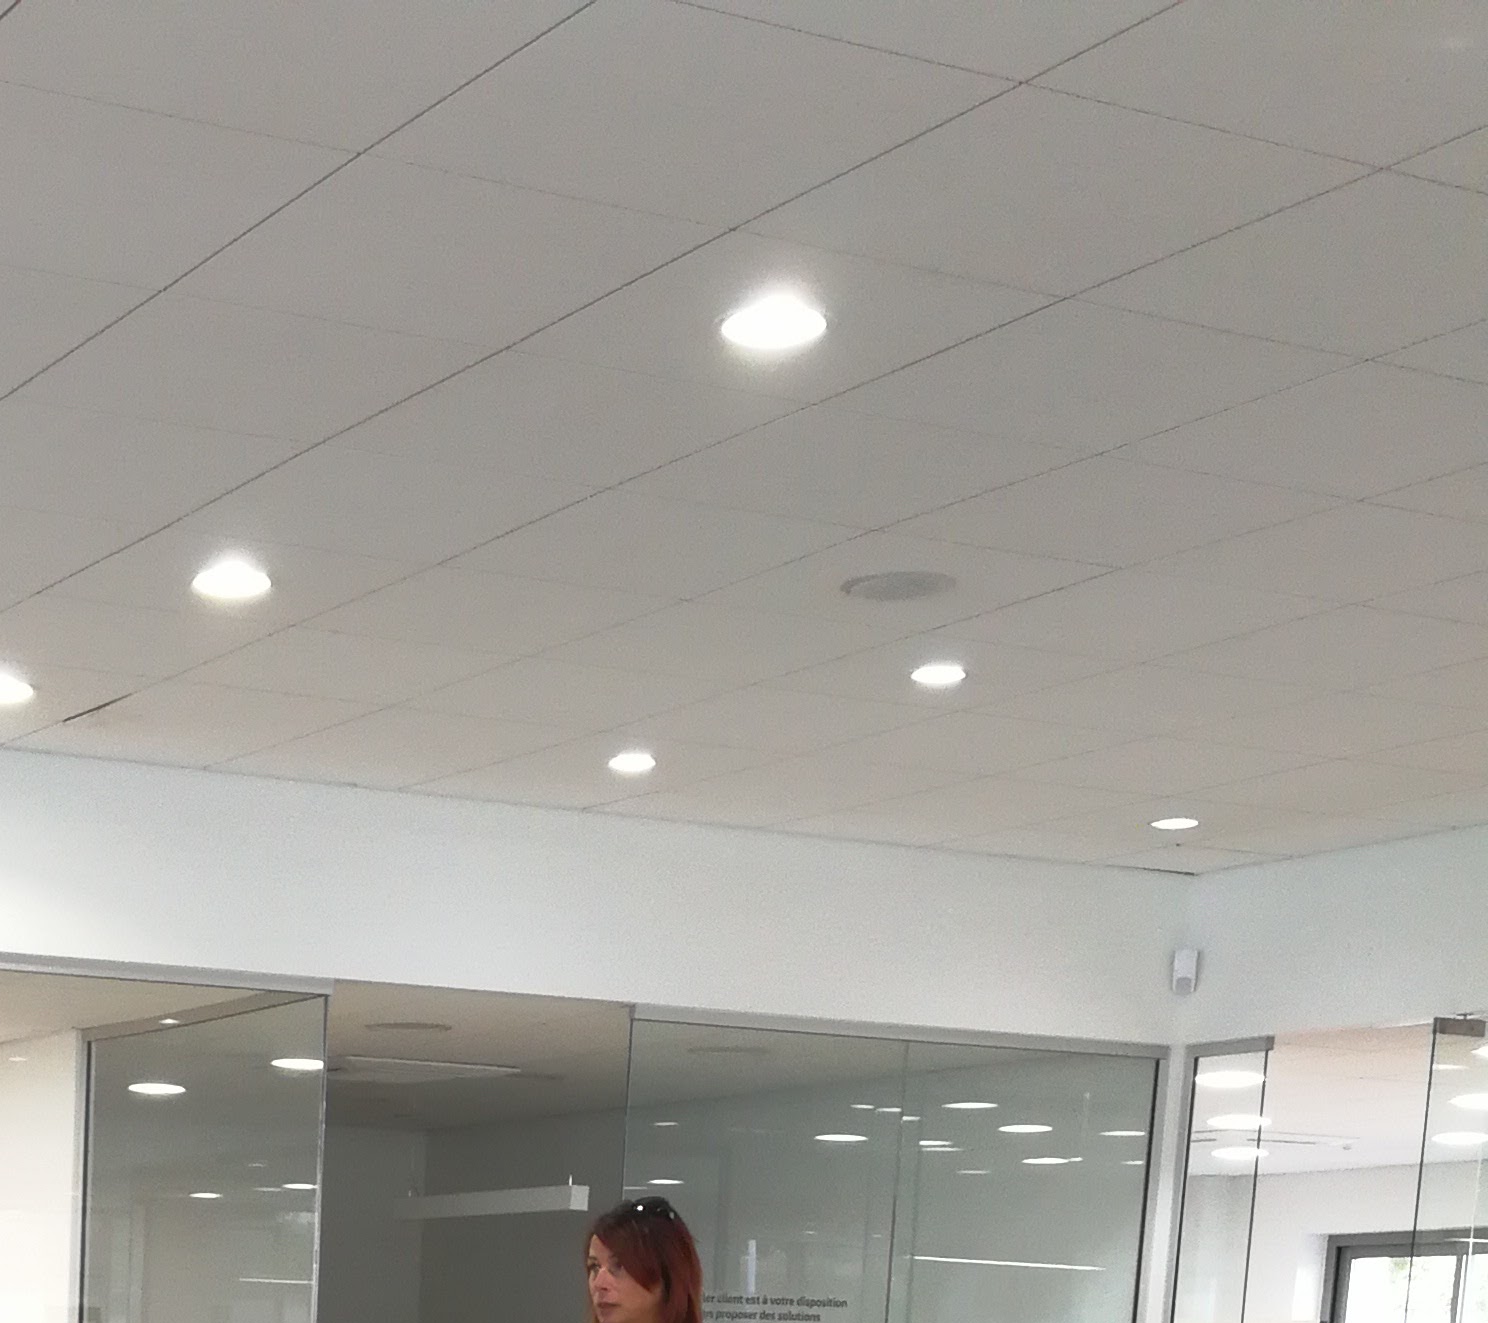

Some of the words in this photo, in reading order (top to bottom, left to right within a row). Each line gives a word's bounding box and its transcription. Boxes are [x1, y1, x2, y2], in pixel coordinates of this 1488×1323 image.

[745, 1295, 760, 1305] est
[770, 1297, 795, 1306] votre
[797, 1296, 848, 1309] disposition
[716, 1310, 757, 1321] proposer
[759, 1310, 775, 1320] des
[777, 1310, 821, 1322] solutions
